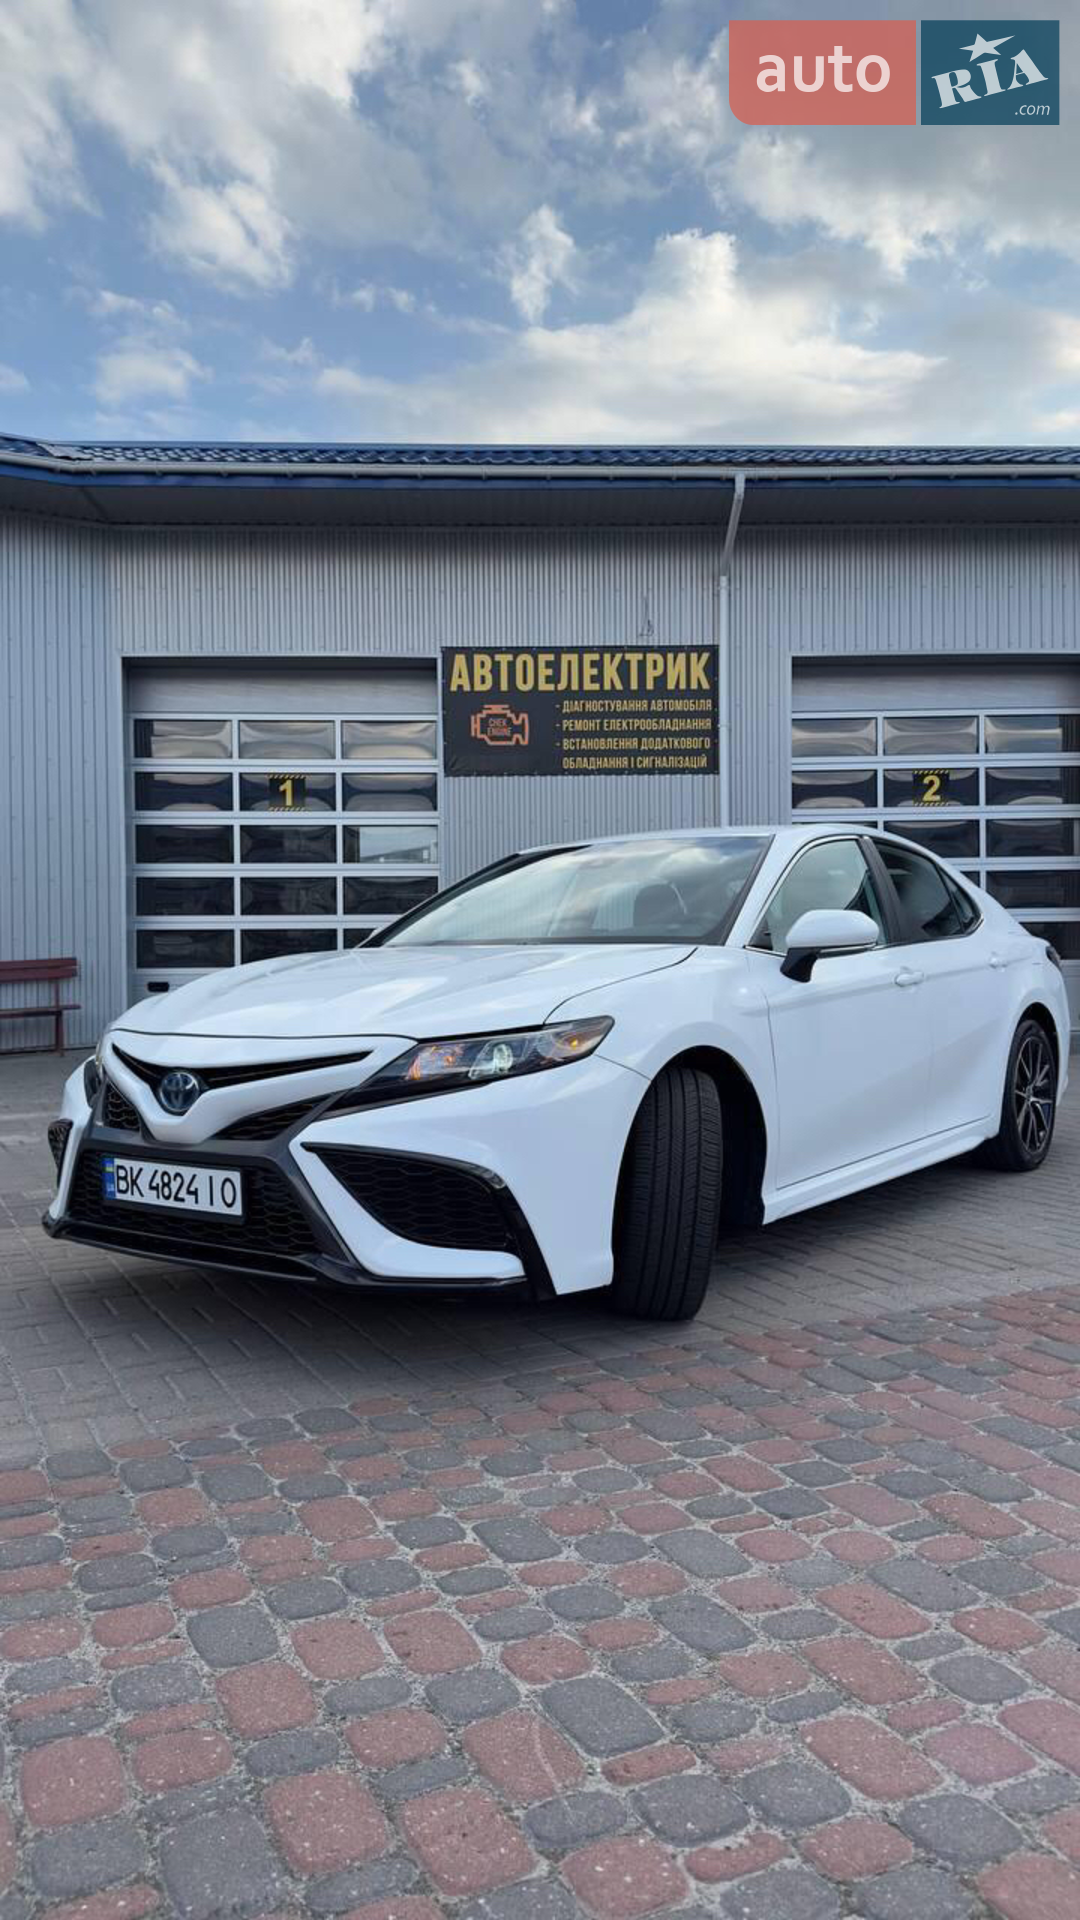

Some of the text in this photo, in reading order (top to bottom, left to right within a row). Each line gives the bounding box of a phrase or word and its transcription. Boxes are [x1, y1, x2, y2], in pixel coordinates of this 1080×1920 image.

[450, 652, 711, 692] АВТОЕЛЕКТРИК
[562, 700, 648, 714] ДІАГНОСТУВАННЯ
[650, 699, 712, 712] АВТОМОБІЛЯ
[562, 719, 601, 732] РЕМОНТ
[603, 718, 712, 731] ЕЛЕКТРООБЛАДНАННЯ
[562, 738, 639, 750] ВСТАНОВЛЕННЯ
[640, 737, 711, 750] ДОДАТКОВОГО
[562, 757, 628, 770] ОБЛАДНАННЯ
[279, 780, 293, 806] 1
[923, 775, 941, 801] 2
[116, 1165, 237, 1208] BK 4824 IO
